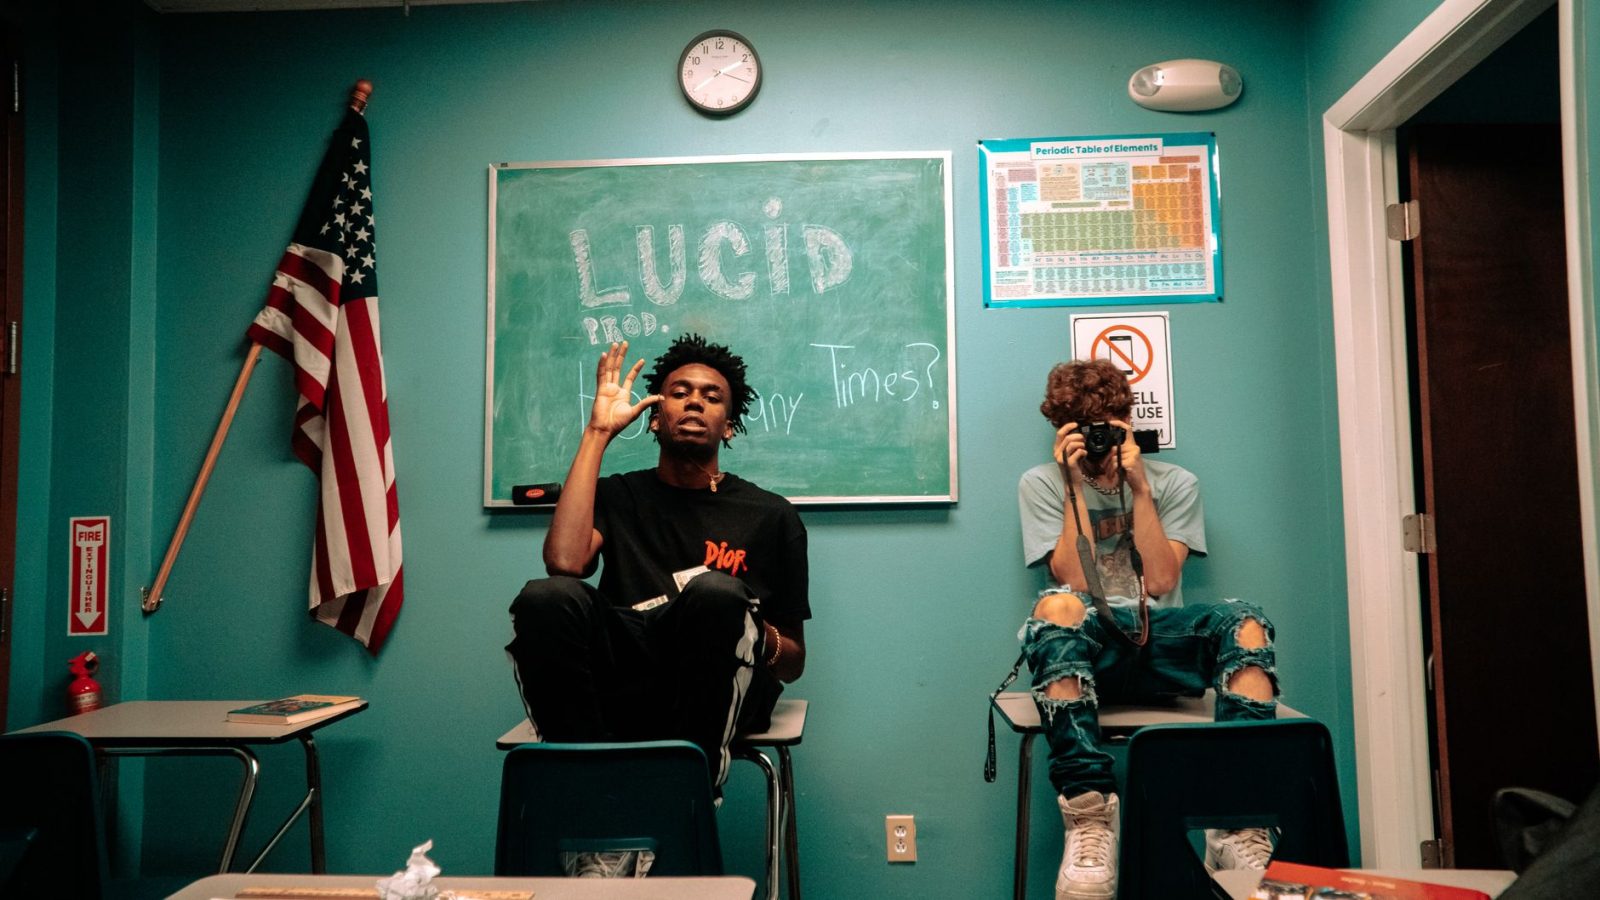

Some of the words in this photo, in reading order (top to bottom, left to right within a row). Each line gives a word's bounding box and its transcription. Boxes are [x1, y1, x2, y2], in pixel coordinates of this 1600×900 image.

[703, 45, 709, 55] 11
[715, 41, 725, 50] 12
[732, 44, 736, 53] 1
[691, 56, 701, 66] 10
[742, 53, 749, 63] 2
[1035, 146, 1074, 155] Periodic
[1075, 145, 1102, 154] Table
[1103, 144, 1113, 153] of
[1114, 143, 1158, 153] Elements
[582, 312, 670, 345] PROD.
[810, 343, 940, 409] Times?
[1136, 406, 1164, 419] USE
[78, 531, 102, 542] FIRE
[84, 546, 94, 613] EXTINGUISHER
